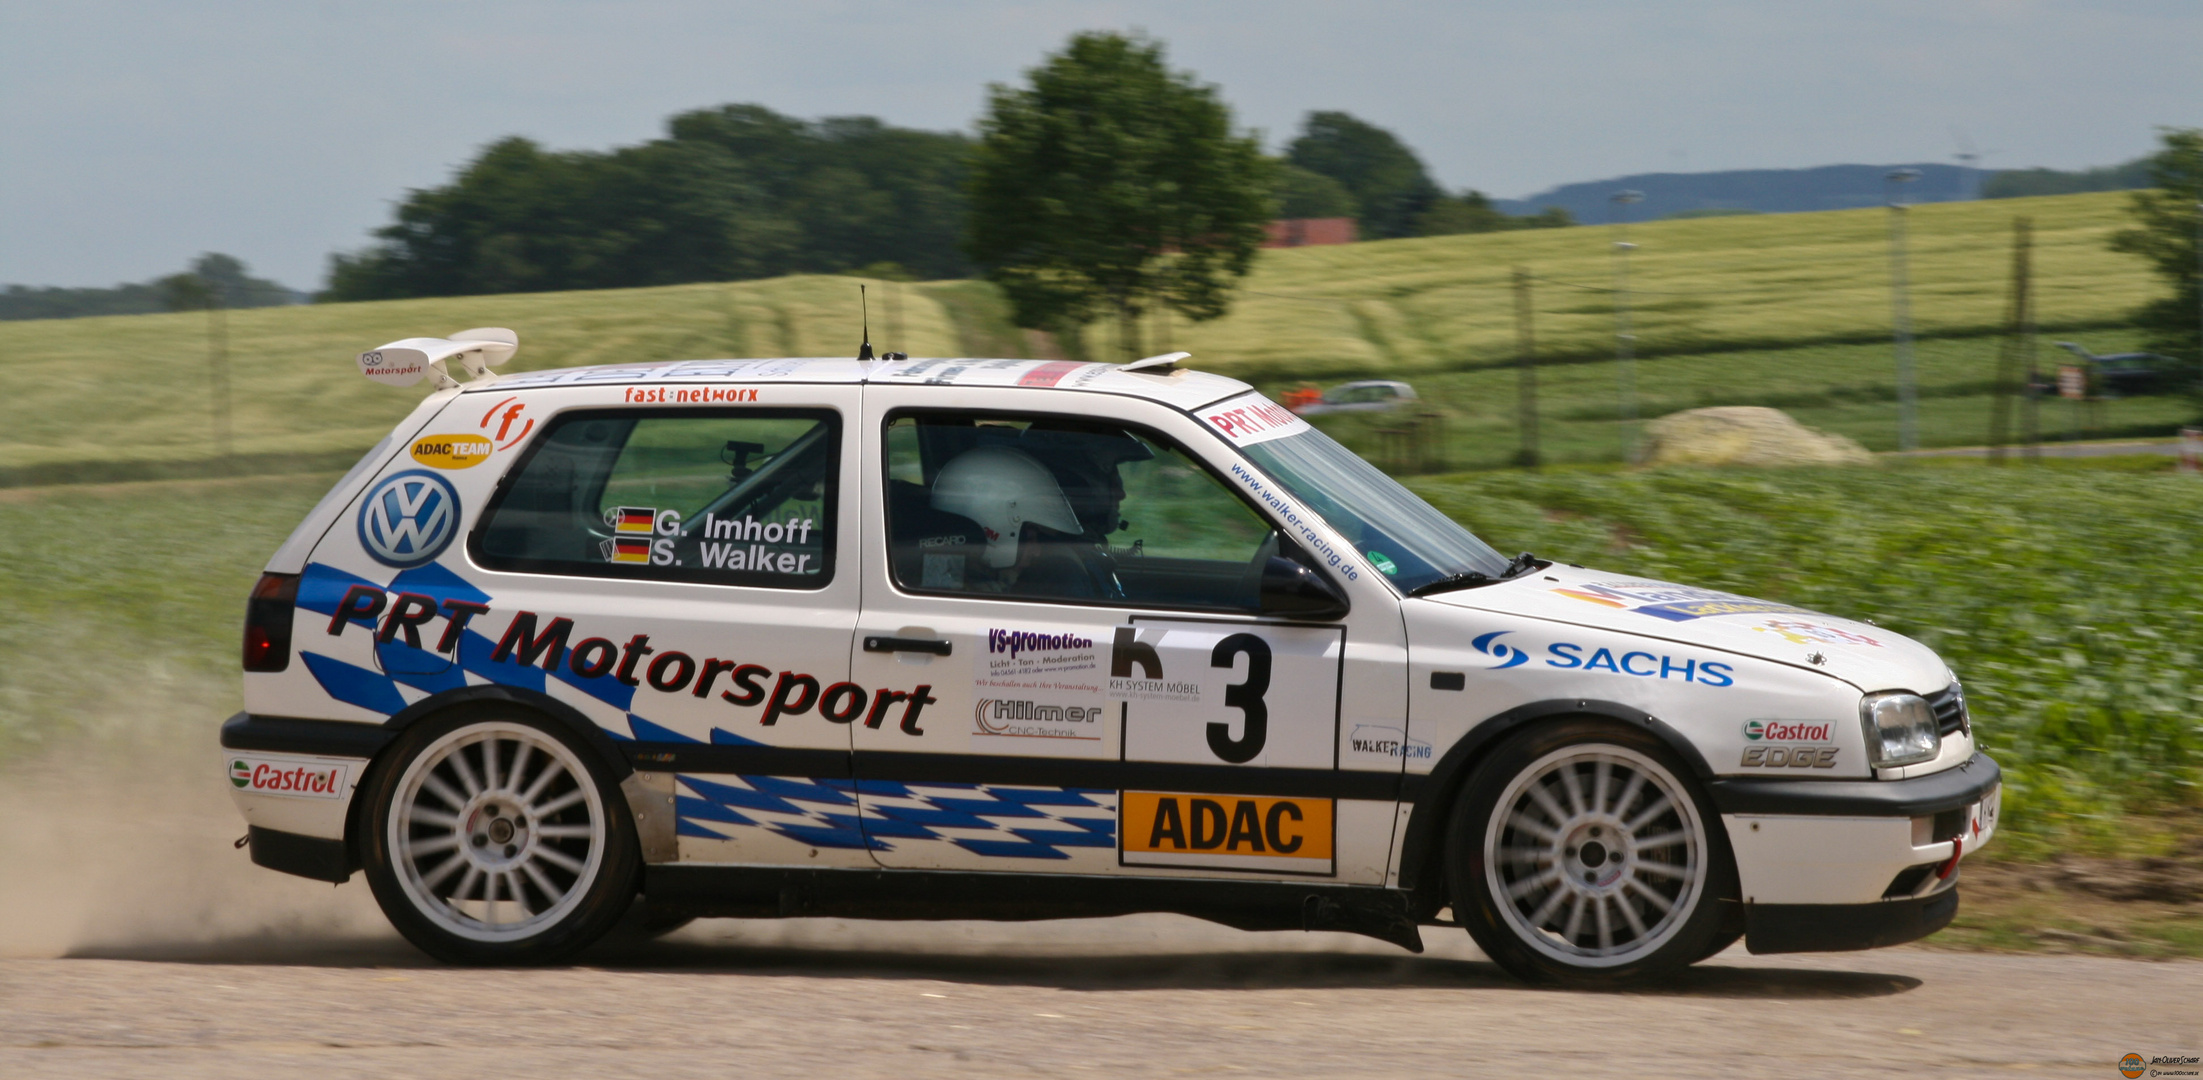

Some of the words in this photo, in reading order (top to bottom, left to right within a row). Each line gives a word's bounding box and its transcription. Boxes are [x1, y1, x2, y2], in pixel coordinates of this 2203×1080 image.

[365, 365, 422, 377] Motorsport
[1208, 408, 1266, 438] PRT
[655, 509, 688, 537] G.
[704, 511, 812, 544] Imhoff
[1231, 463, 1358, 581] www.walker-racing.de
[652, 538, 682, 566] S.
[700, 541, 811, 573] Walker
[919, 535, 966, 549] RECARO
[327, 583, 491, 654] PRT
[490, 609, 937, 737] Motorsport
[1018, 658, 1034, 666] Ton
[1042, 653, 1095, 664] Moderation
[1545, 642, 1734, 687] SACHS
[1109, 679, 1123, 689] KH
[1126, 680, 1163, 692] SYSTEM
[1166, 682, 1200, 694] MÖBEL
[1206, 633, 1272, 764] 3
[994, 699, 1102, 722] Hilmer
[1009, 726, 1076, 737] CNC-Technik
[1765, 721, 1829, 741] Castrol
[1740, 746, 1839, 768] EDGE
[253, 764, 337, 793] Castrol
[1149, 797, 1304, 854] ADAC
